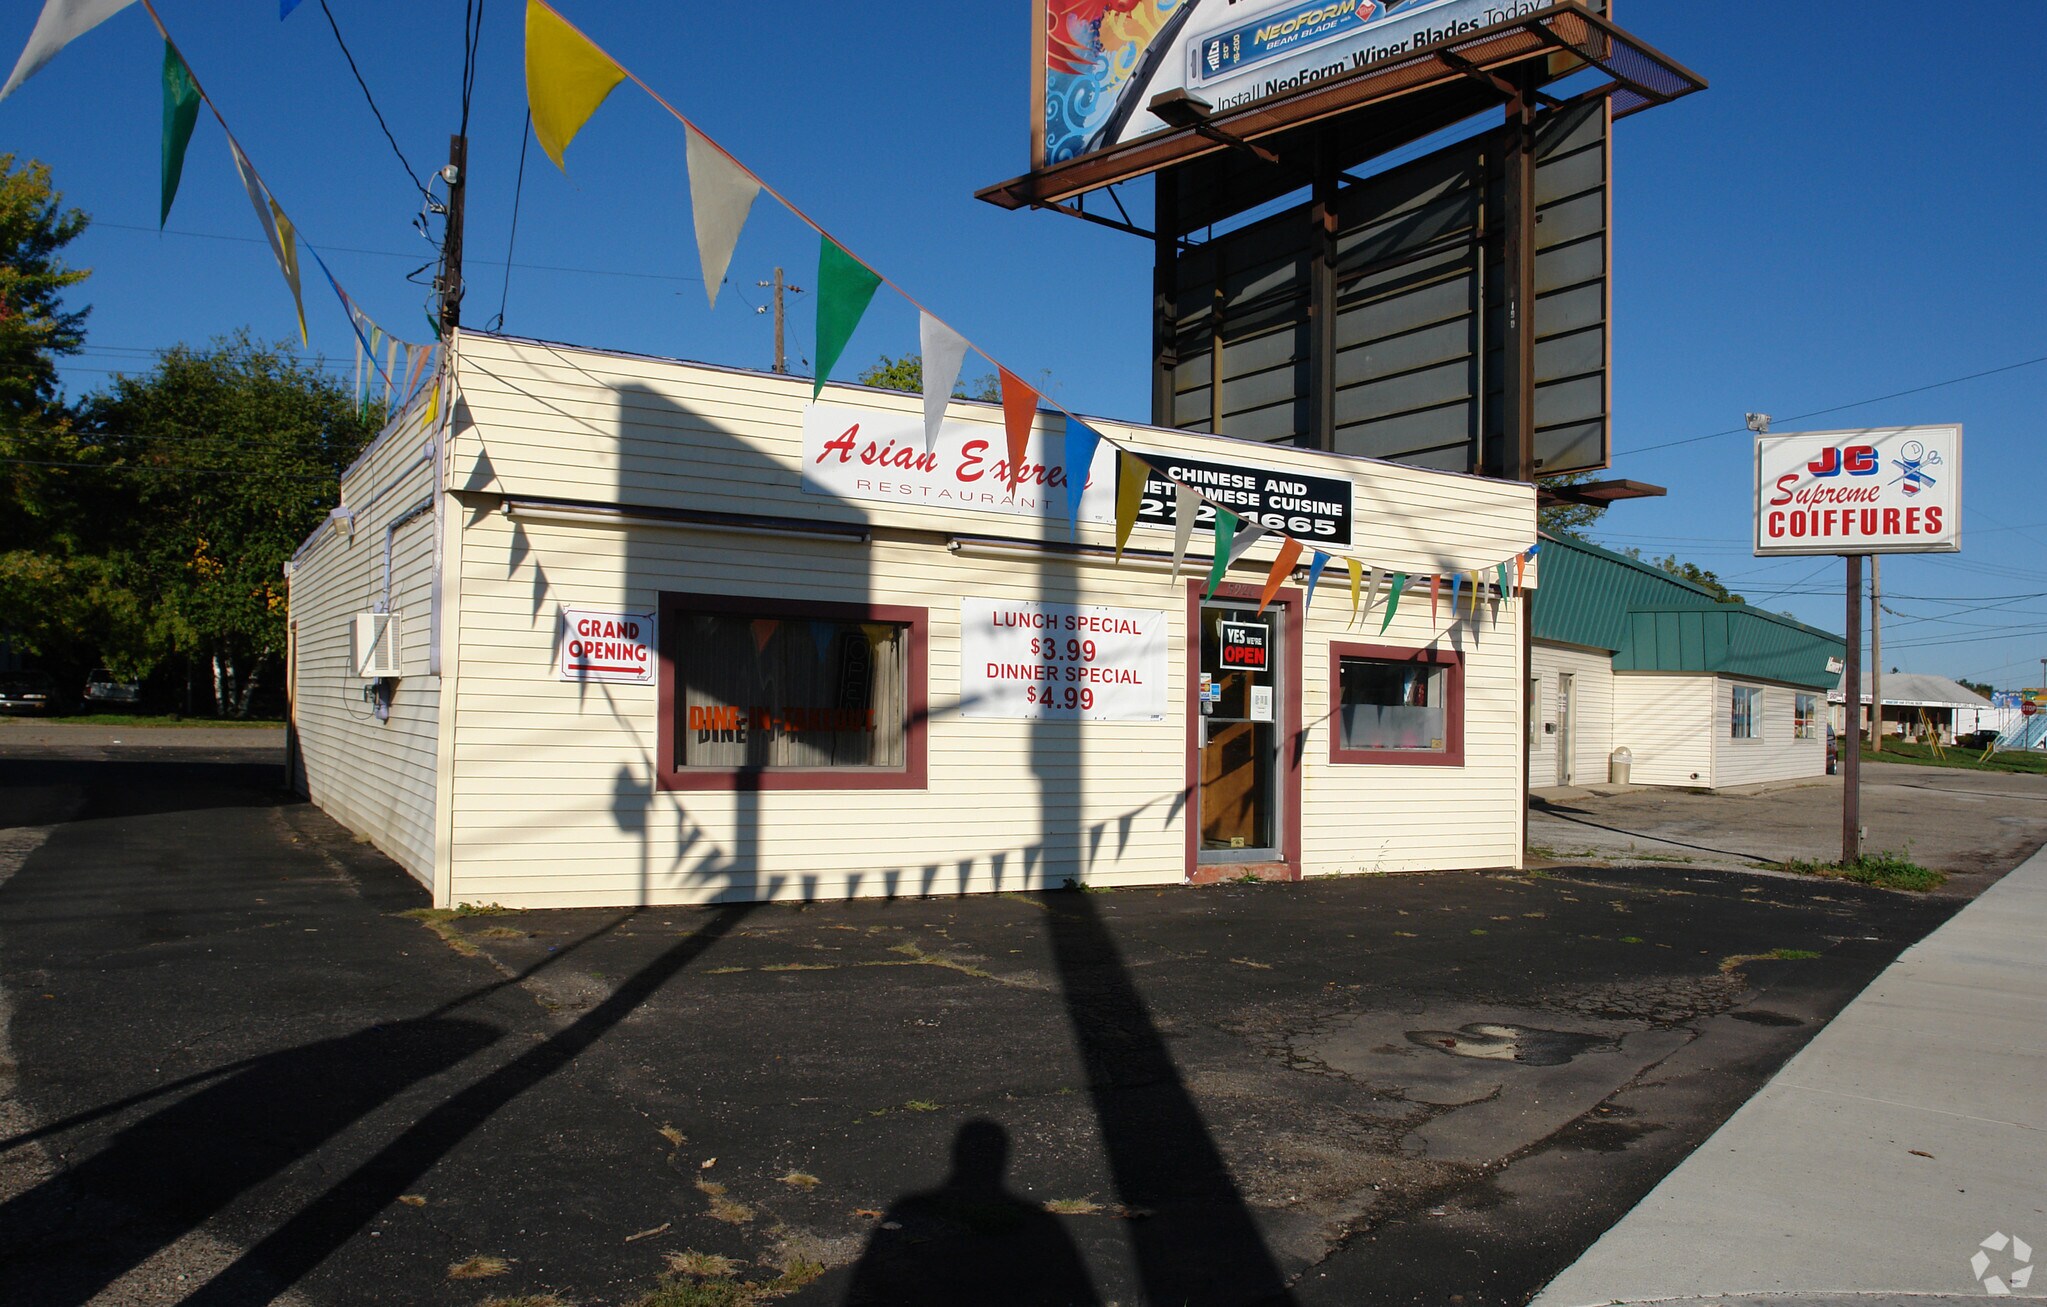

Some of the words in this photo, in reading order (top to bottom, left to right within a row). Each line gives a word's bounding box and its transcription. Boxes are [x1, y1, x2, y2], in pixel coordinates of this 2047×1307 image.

[1254, 0, 1356, 45] NEOFORM
[1266, 36, 1299, 50] BEAM
[1301, 20, 1338, 38] BLADE
[1207, 40, 1220, 71] TRICO
[1218, 84, 1260, 112] Install
[1352, 38, 1408, 68] Wiper
[1413, 17, 1479, 49] Blades
[1483, 0, 1542, 27] Today
[816, 423, 938, 473] Asian
[956, 440, 1094, 492] Expre
[1807, 445, 1880, 478] JC
[857, 479, 1054, 510] RESTAURANT
[1167, 466, 1256, 490] CHINESE
[1264, 479, 1308, 496] AND
[1769, 473, 1881, 512] Supreme
[1268, 495, 1343, 517] CUISINE
[1768, 506, 1943, 538] COIFFURES
[577, 618, 640, 640] GRAND
[992, 611, 1059, 630] LUNCH
[1064, 615, 1143, 635] SPECIAL
[1227, 628, 1246, 644] YES
[568, 640, 647, 662] OPENING
[1030, 637, 1097, 663] $3.99
[1224, 645, 1265, 665] OPEN
[986, 663, 1060, 681] DINNER
[1065, 666, 1144, 685] SPECIAL
[1026, 685, 1095, 711] $4.99
